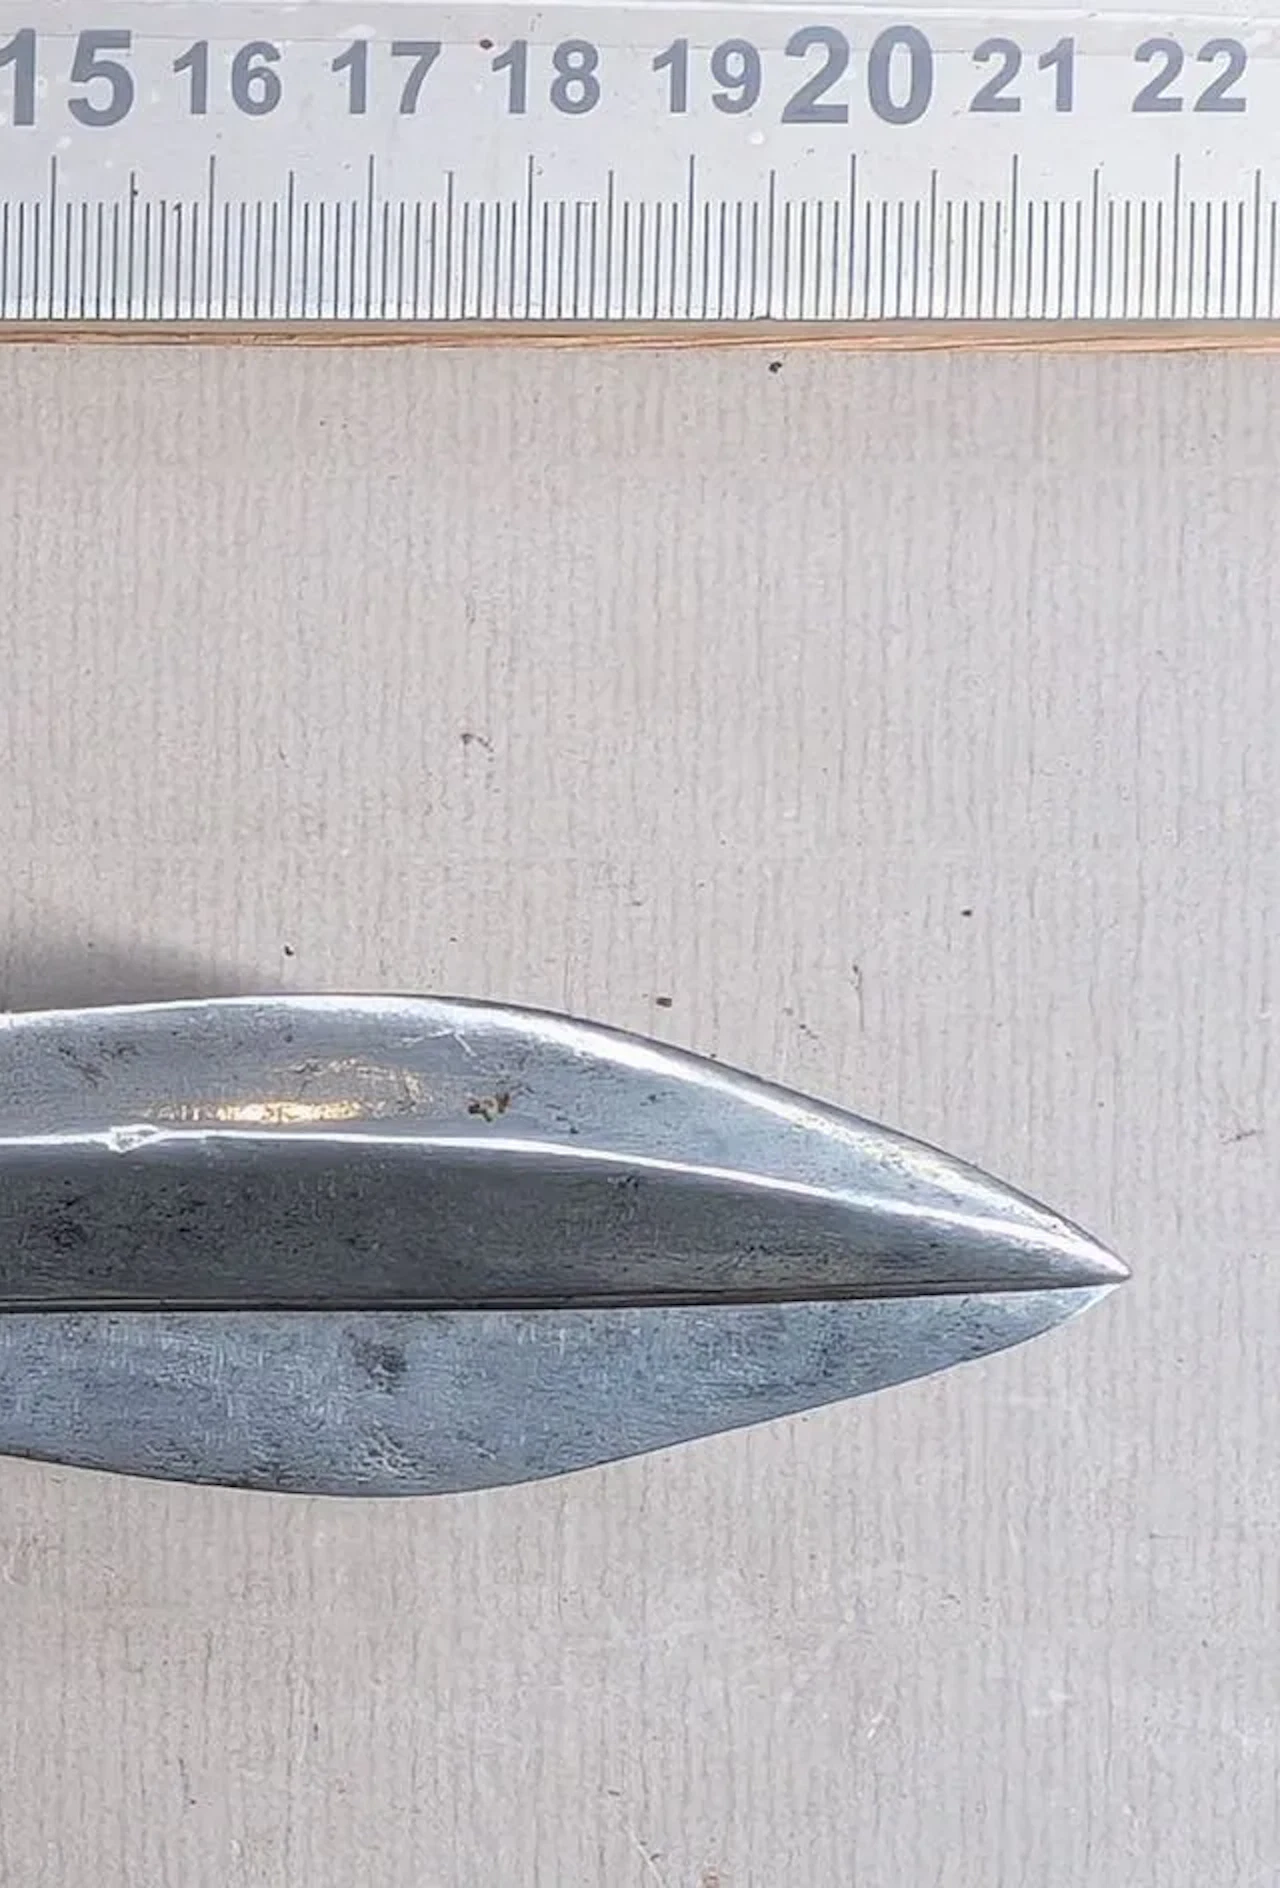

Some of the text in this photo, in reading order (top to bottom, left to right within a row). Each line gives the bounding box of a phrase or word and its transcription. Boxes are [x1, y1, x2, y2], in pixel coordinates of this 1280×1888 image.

[174, 40, 282, 115] 16
[331, 39, 441, 115] 17
[492, 39, 600, 115] 18
[653, 38, 761, 114] 19
[781, 25, 933, 125] 20
[969, 37, 1074, 113] 21
[1132, 37, 1248, 113] 22
